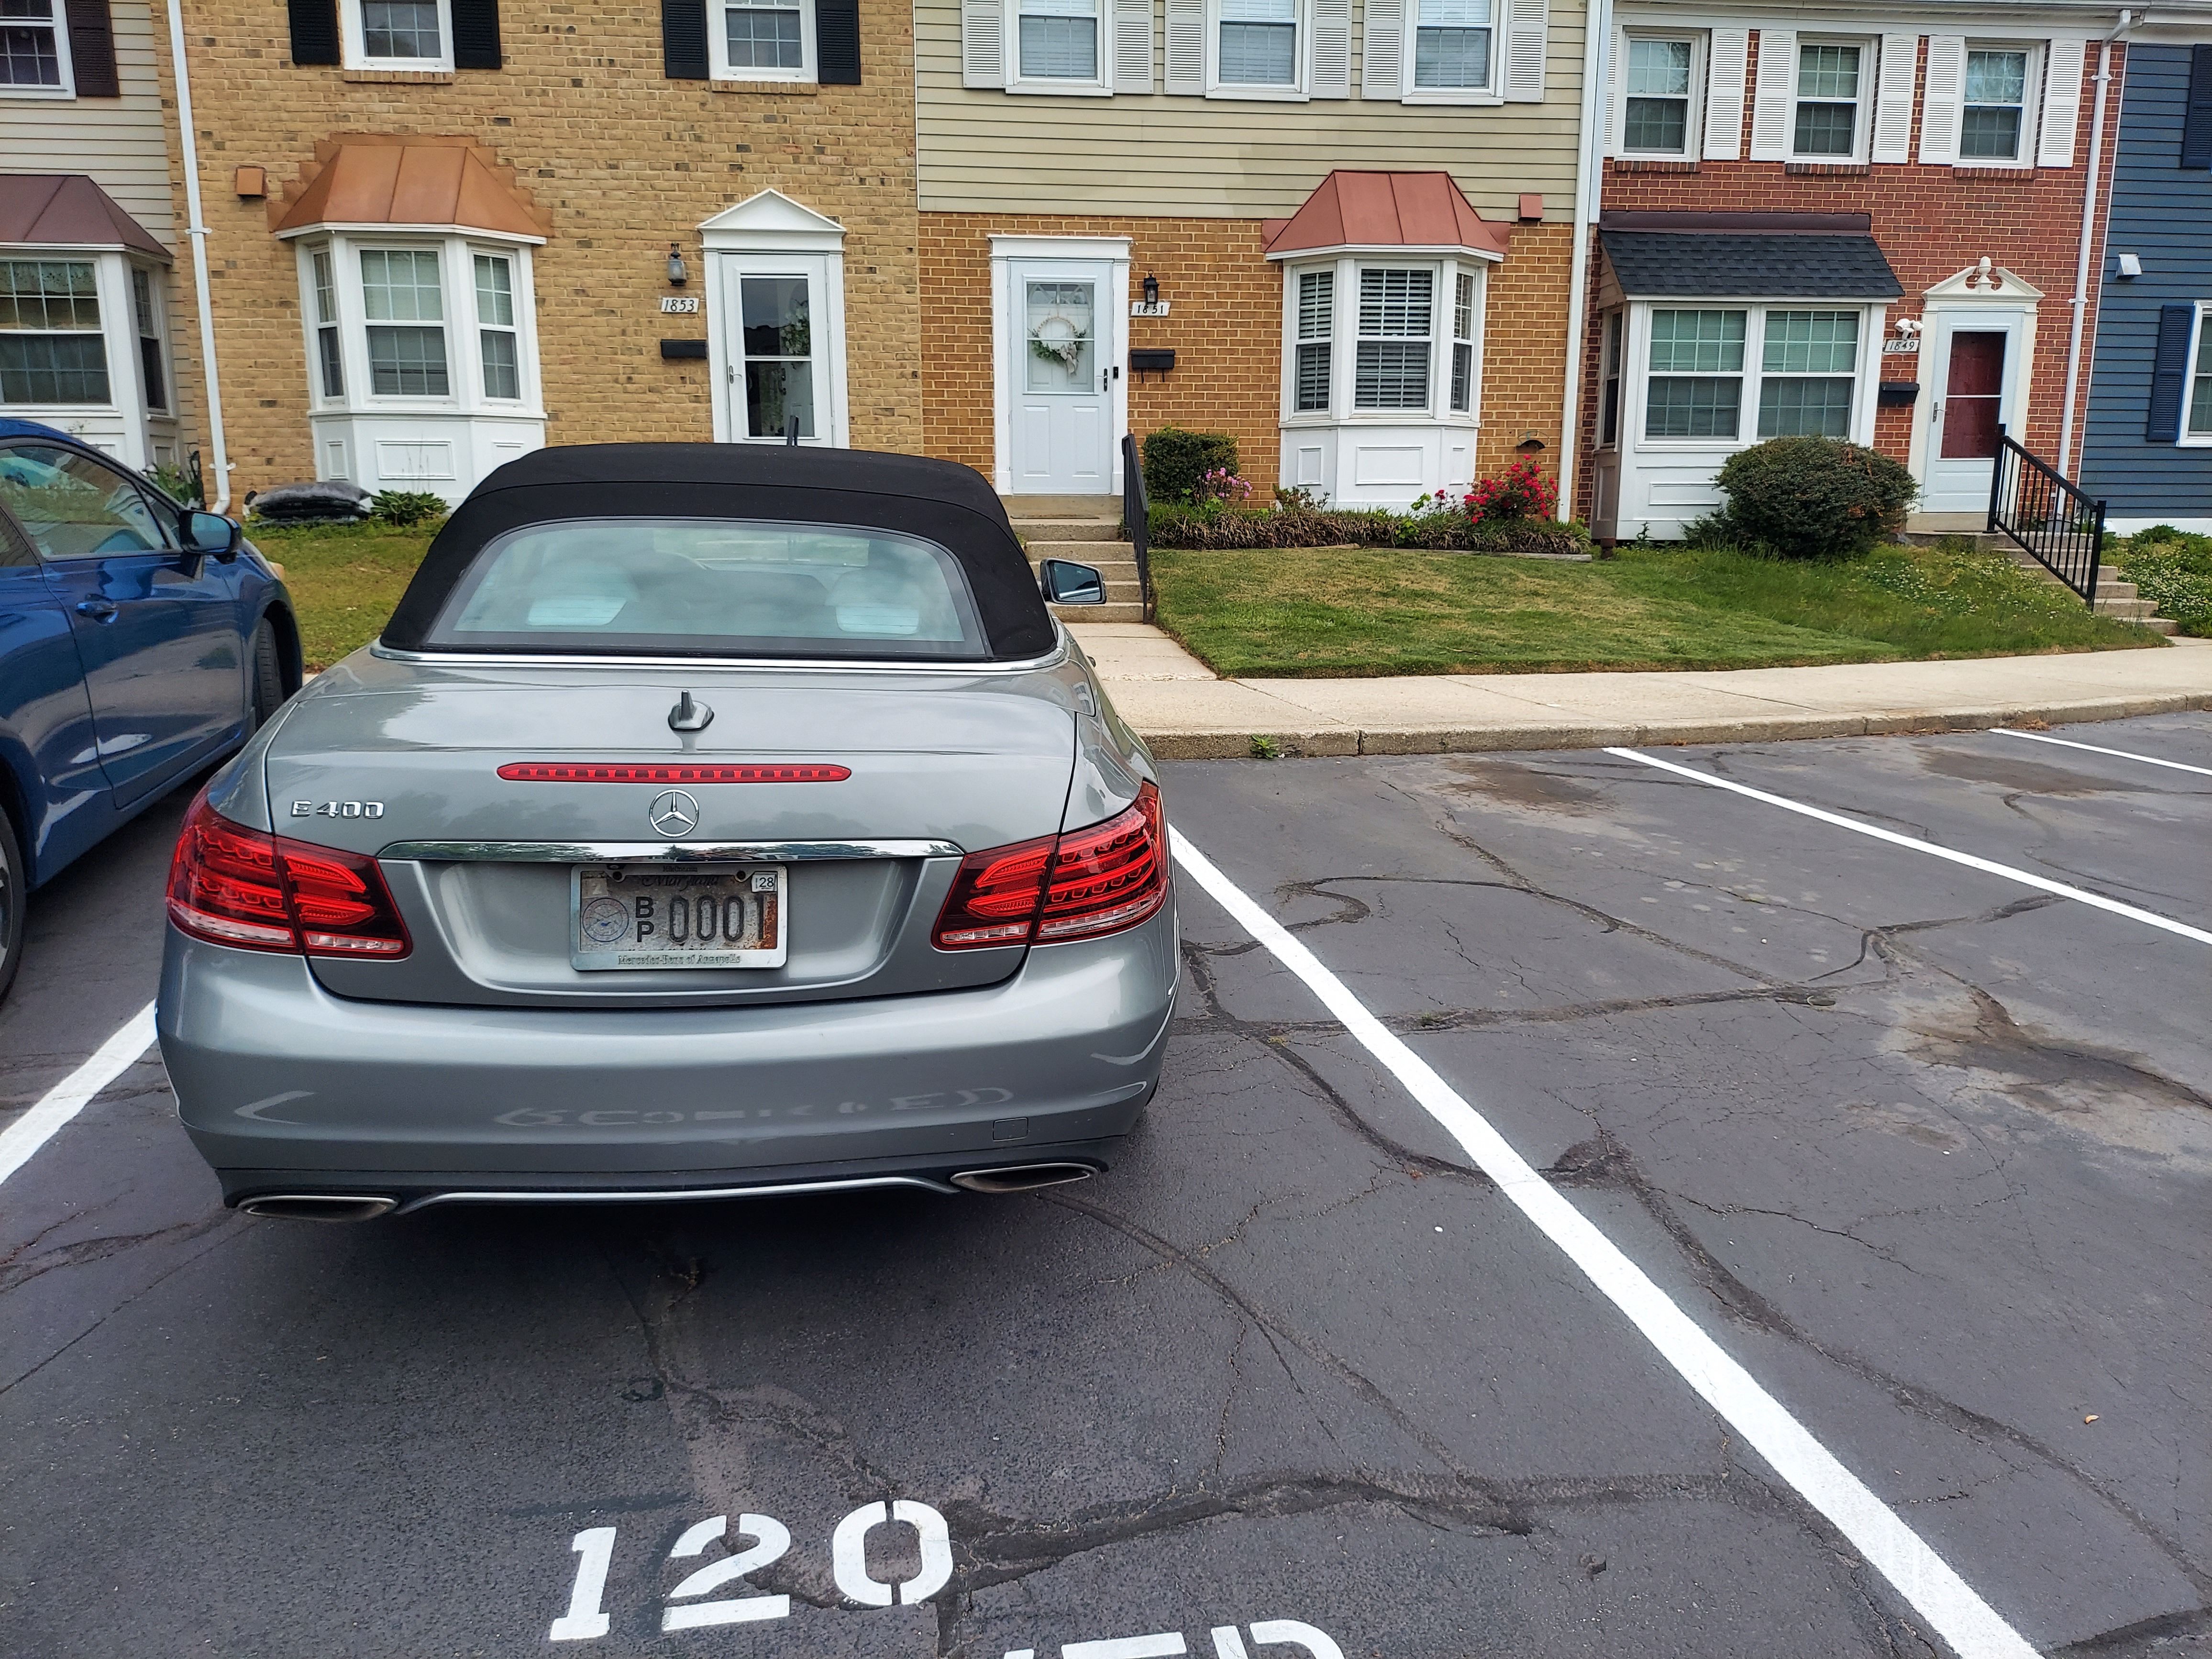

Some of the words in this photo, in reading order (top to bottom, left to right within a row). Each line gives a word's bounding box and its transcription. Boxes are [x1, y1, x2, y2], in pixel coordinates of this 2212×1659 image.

[664, 299, 695, 311] 1853
[1138, 305, 1163, 314] 1851
[1890, 341, 1914, 350] 1849
[291, 800, 311, 817] E
[316, 801, 384, 819] 400
[759, 877, 774, 887] 28
[669, 894, 764, 942] 0001
[549, 1499, 953, 1641] 120
